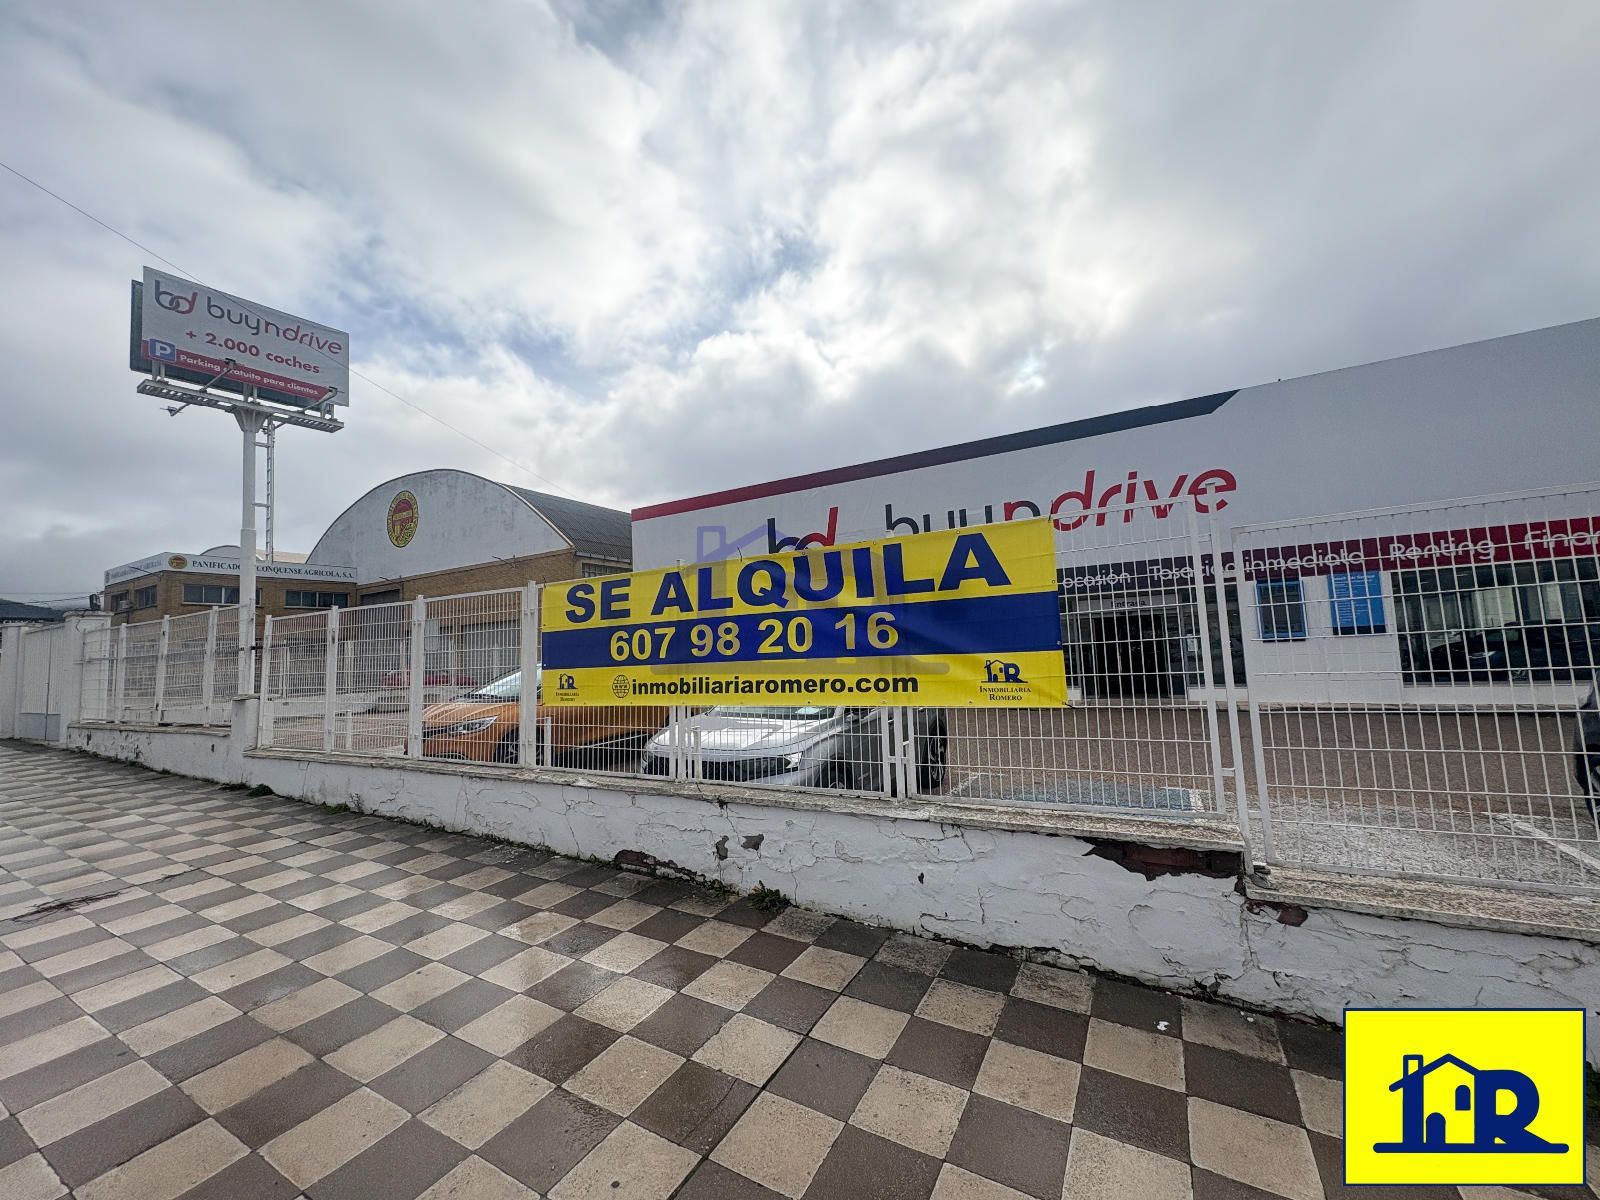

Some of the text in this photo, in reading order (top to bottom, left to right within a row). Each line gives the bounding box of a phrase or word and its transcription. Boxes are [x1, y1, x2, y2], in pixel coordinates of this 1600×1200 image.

[207, 296, 343, 355] buyndrive
[155, 342, 171, 356] P
[206, 332, 260, 357] 2.000
[265, 351, 320, 374] coches
[180, 354, 221, 372] Parking
[263, 377, 285, 388] para
[287, 382, 319, 395] clientes
[1389, 537, 1496, 561] Renting
[565, 533, 1013, 624] SE ALQUILA
[609, 611, 900, 662] 607 98 20 16
[632, 675, 919, 695] inmobiliariaromero.com
[989, 693, 1023, 701] ROMERO
